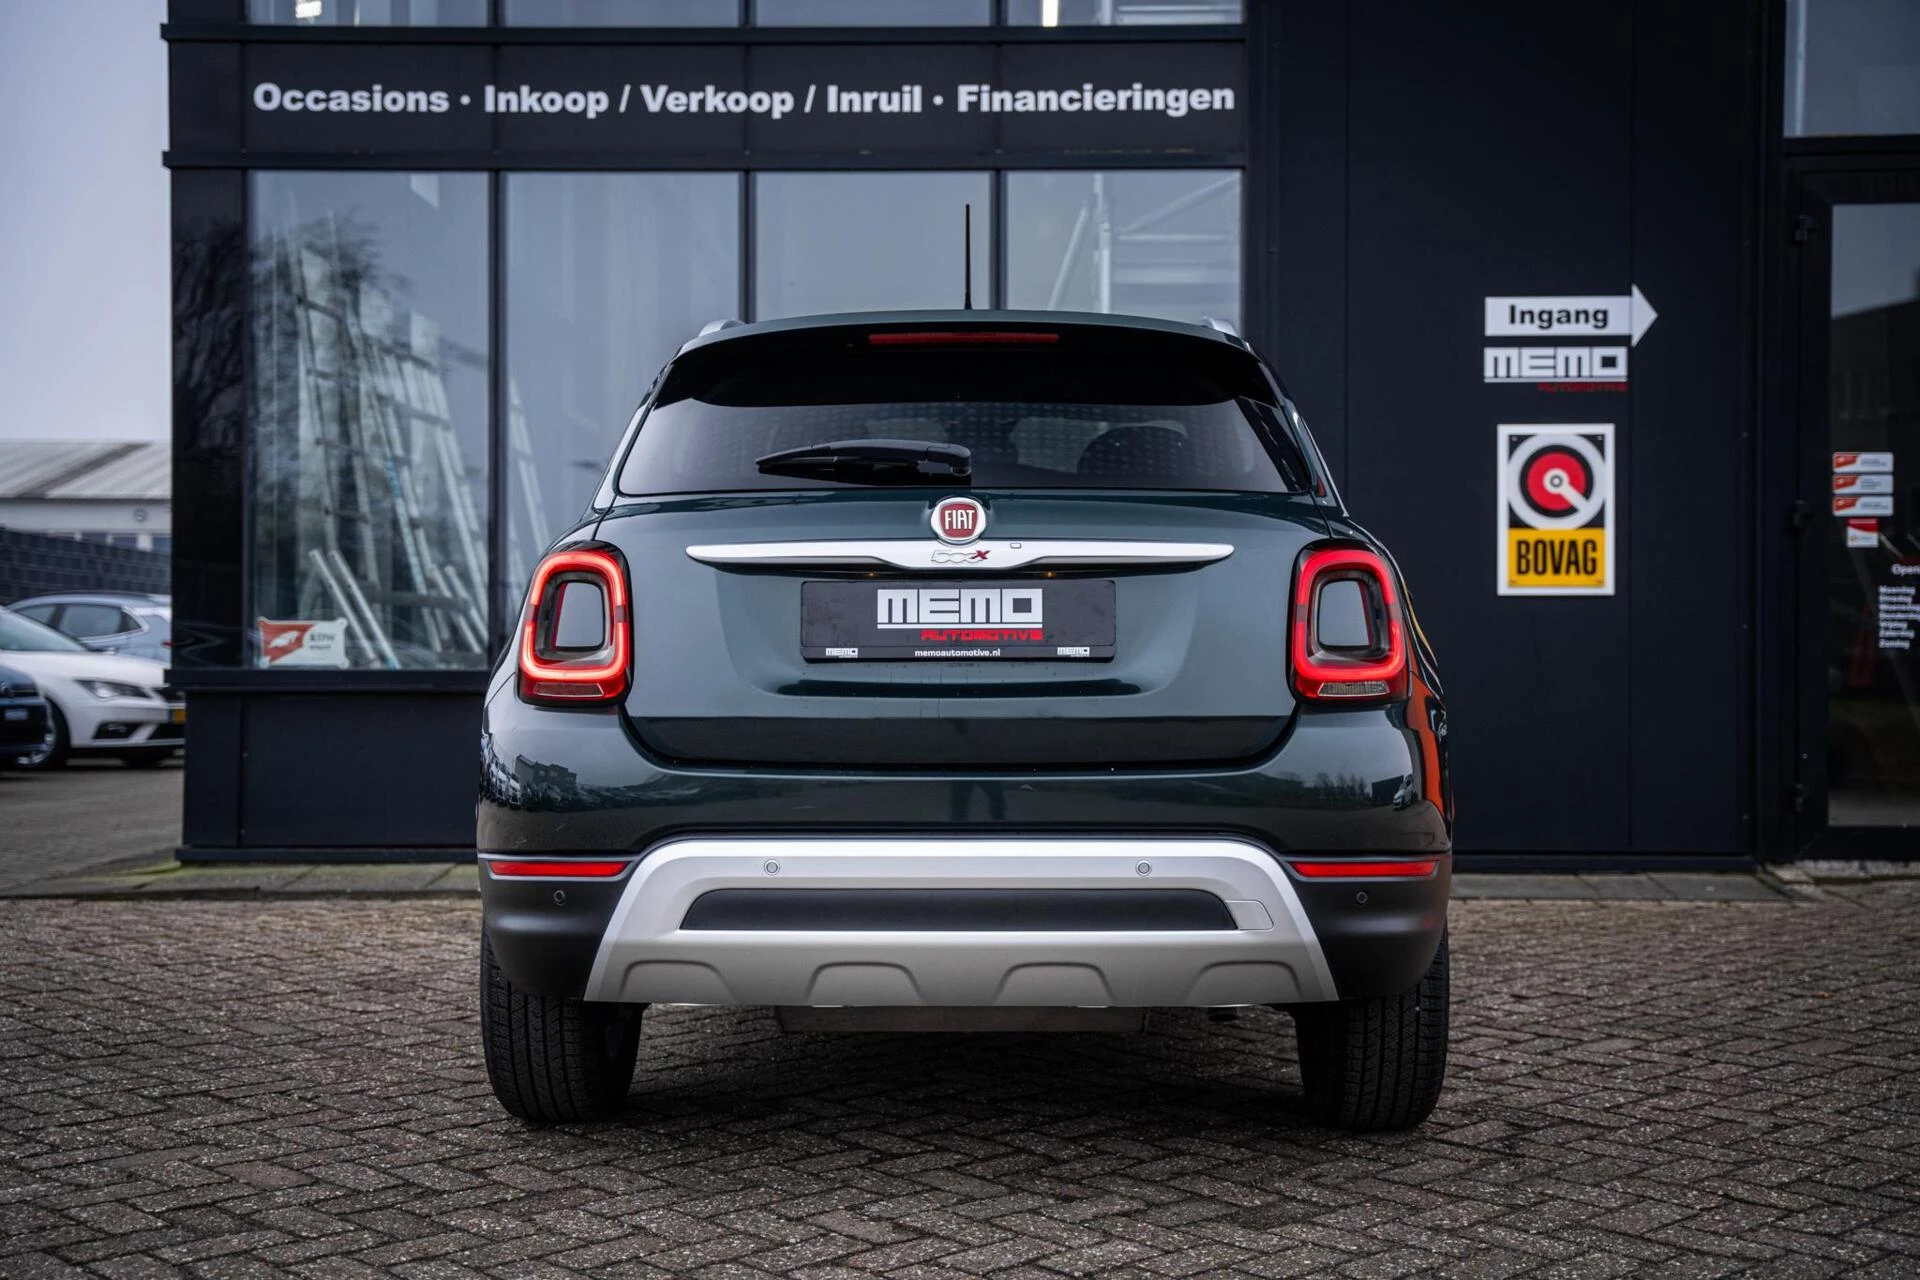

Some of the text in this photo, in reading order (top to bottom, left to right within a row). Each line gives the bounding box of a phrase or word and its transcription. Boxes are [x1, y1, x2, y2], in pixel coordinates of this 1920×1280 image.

[253, 82, 450, 113] Occasions
[484, 84, 610, 120] Inkoop
[639, 84, 795, 120] Verkoop
[827, 84, 923, 114] Inruil
[957, 82, 1235, 118] Financieringen
[1509, 304, 1609, 330] Ingang
[1484, 347, 1628, 378] MEMO
[944, 509, 976, 530] FIAT
[1516, 539, 1598, 576] BOVAG
[877, 588, 1043, 624] MEMO
[921, 629, 1044, 641] AUTOMOTIVE
[914, 648, 1001, 657] memoautomotive.nl
